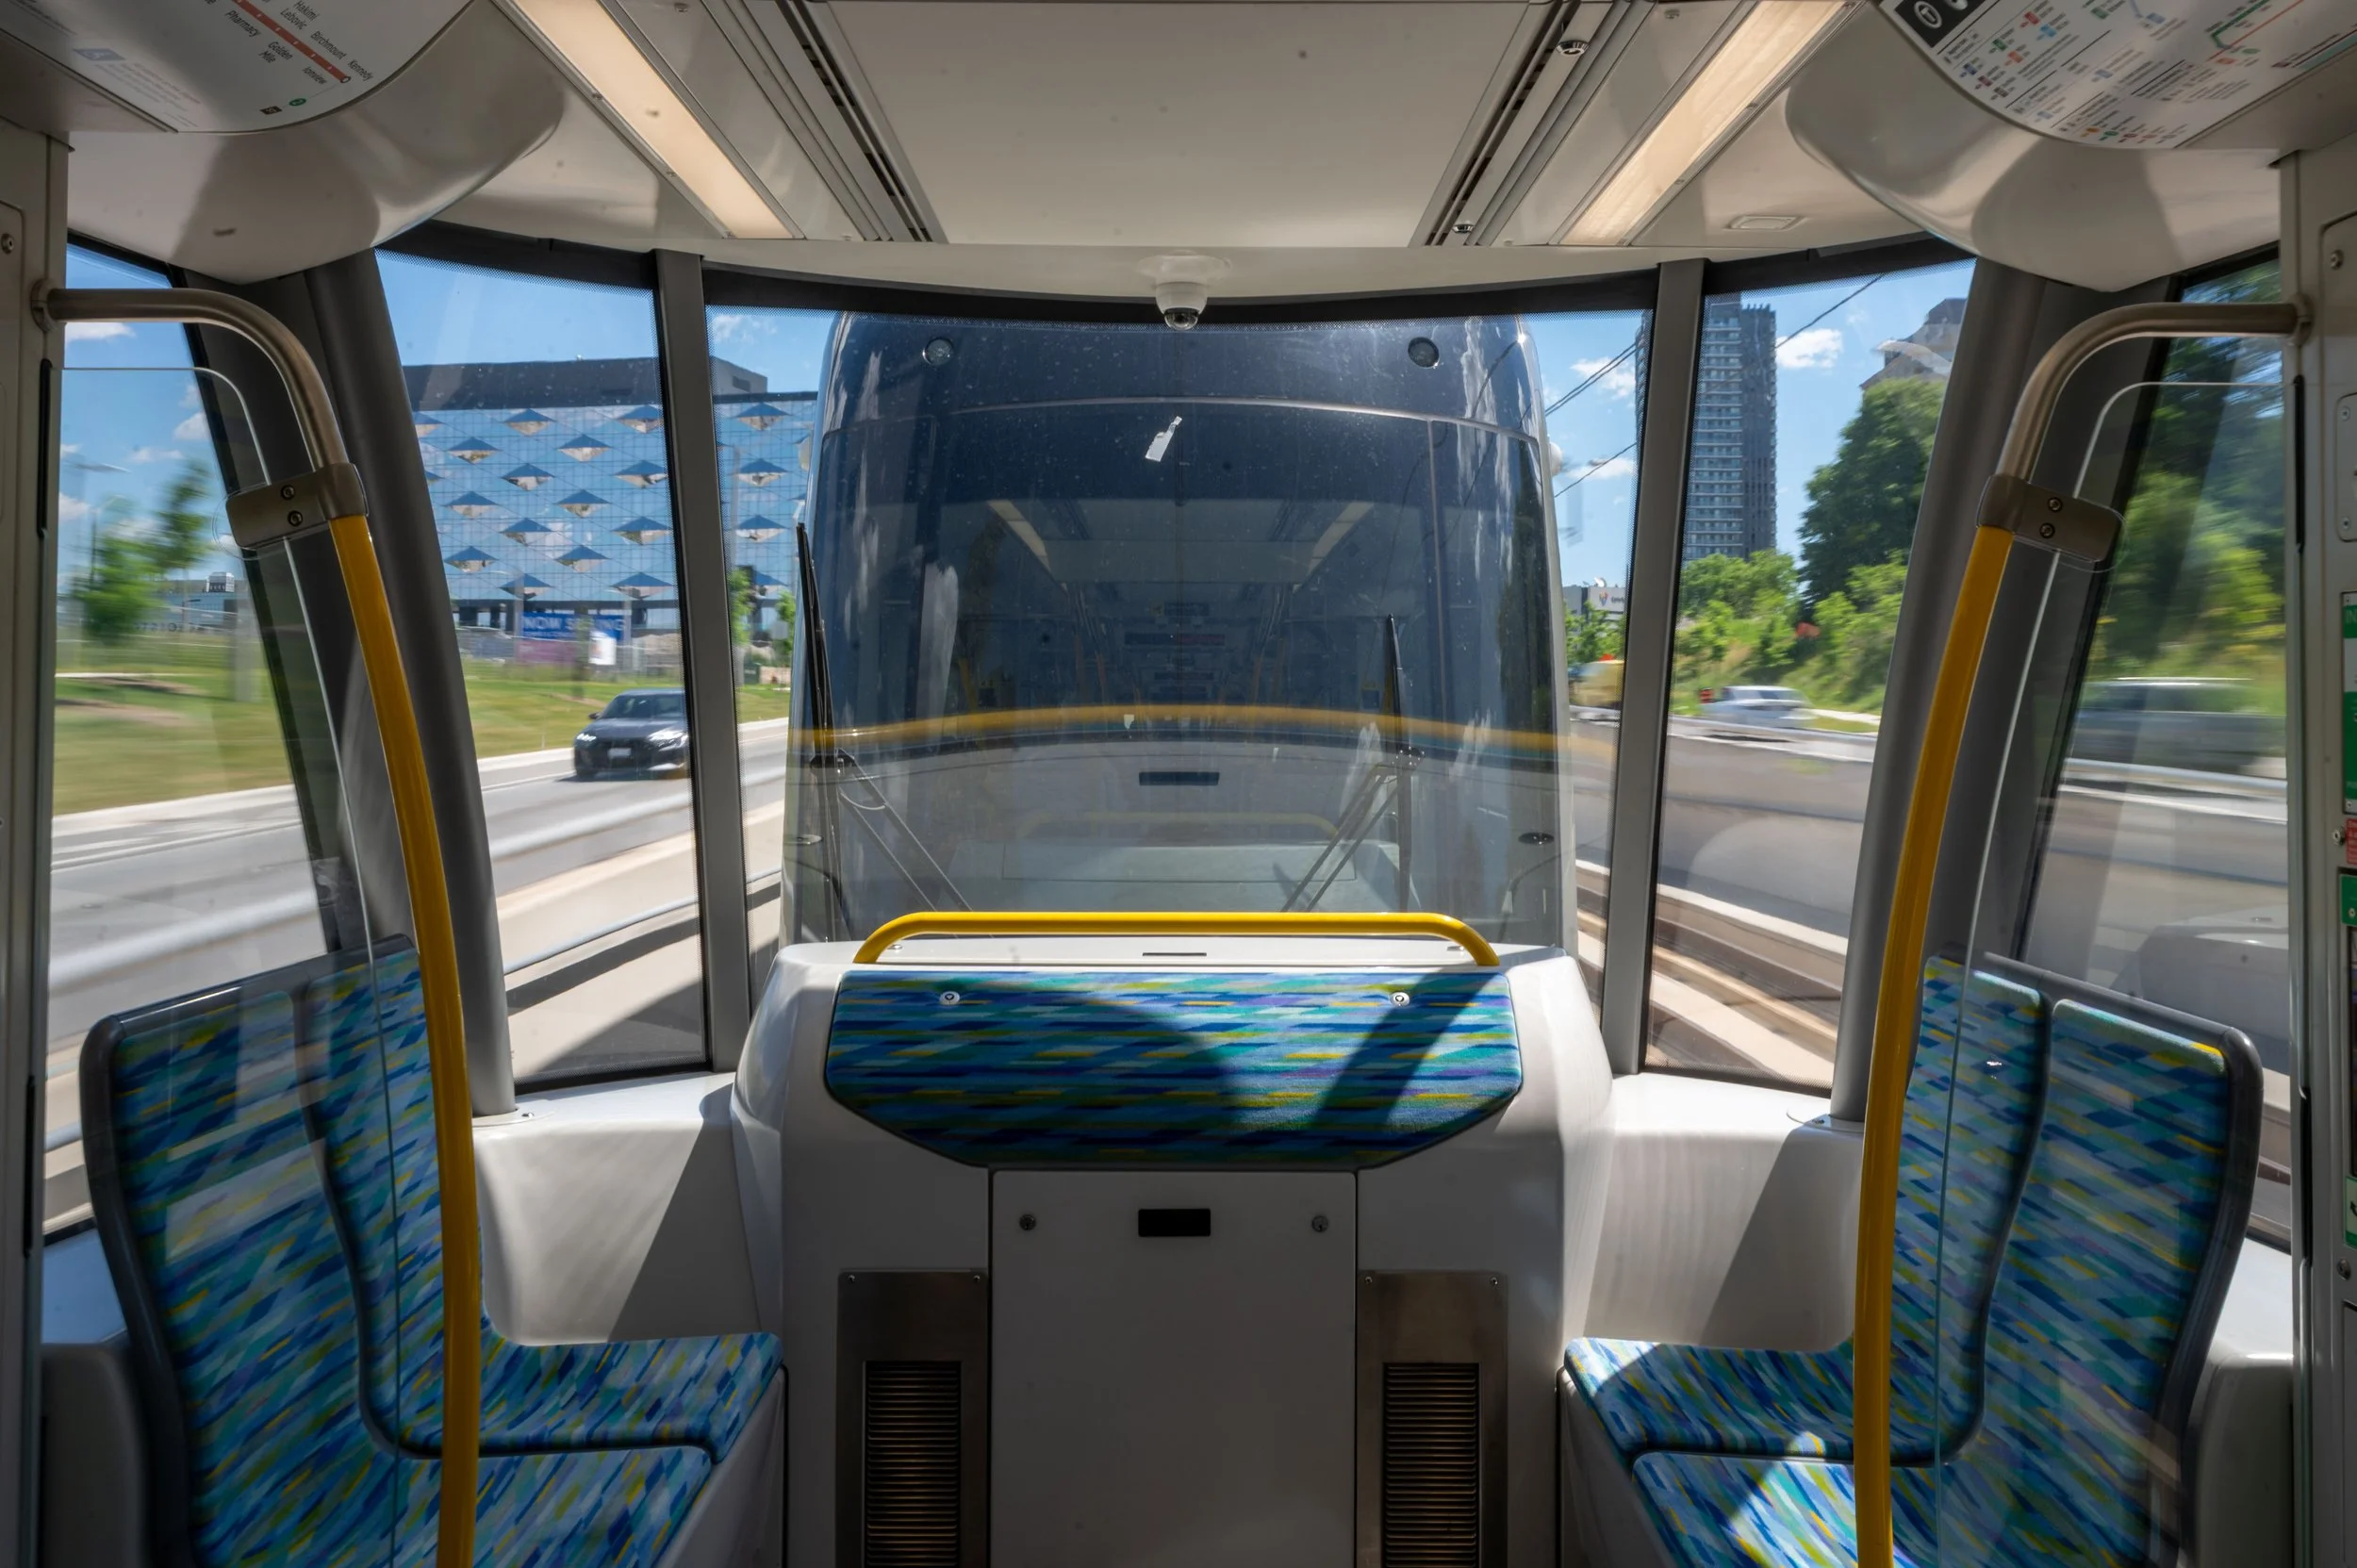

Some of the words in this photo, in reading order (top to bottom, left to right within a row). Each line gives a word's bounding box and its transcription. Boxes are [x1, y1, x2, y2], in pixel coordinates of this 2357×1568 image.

[280, 8, 307, 29] Lebovic
[294, 1, 319, 21] Hakimi
[225, 10, 260, 37] Pharmacy
[268, 41, 292, 59] Golden
[311, 31, 346, 59] Birchmount
[260, 51, 276, 63] Mile
[302, 67, 326, 84] Ionview
[348, 59, 373, 81] Kennedy
[523, 616, 563, 630] NOW
